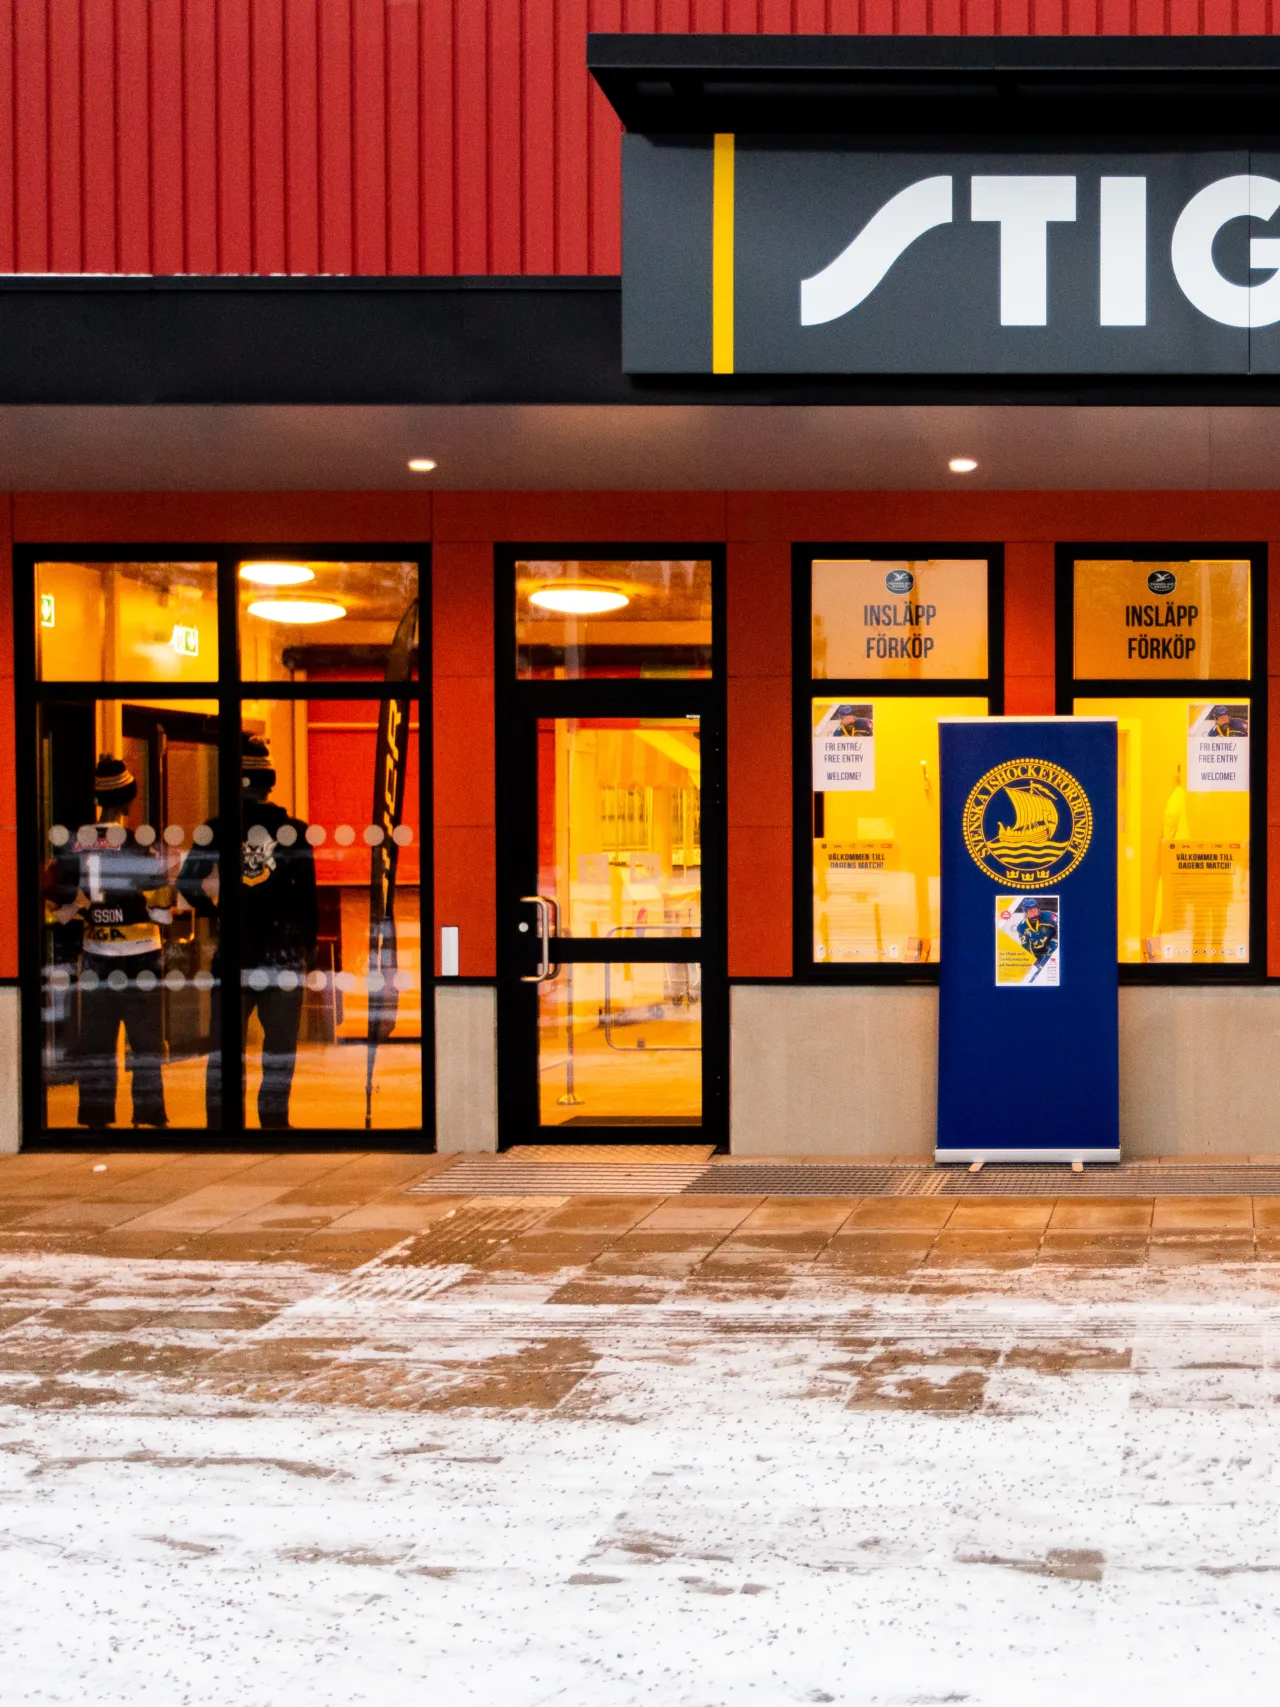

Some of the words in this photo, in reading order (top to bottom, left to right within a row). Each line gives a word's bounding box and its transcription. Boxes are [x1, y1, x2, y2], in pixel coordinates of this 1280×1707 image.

[864, 601, 936, 626] INSLÄPP
[1125, 601, 1199, 627] INSLÄPP
[866, 633, 934, 658] FÖRKÖP
[1128, 634, 1196, 659] FÖRKÖP
[825, 742, 835, 751] FRI
[1200, 742, 1210, 751] FRI
[824, 754, 840, 763] FREE
[842, 754, 863, 763] ENTRY
[1199, 754, 1215, 763] FREE
[1216, 754, 1238, 763] ENTRY
[827, 772, 861, 781] WELCOME!
[1201, 772, 1236, 781] WELCOME!
[969, 793, 991, 859] SVENSKA
[1176, 853, 1218, 861] VÄLKOMMEN
[1220, 853, 1233, 861] TILL
